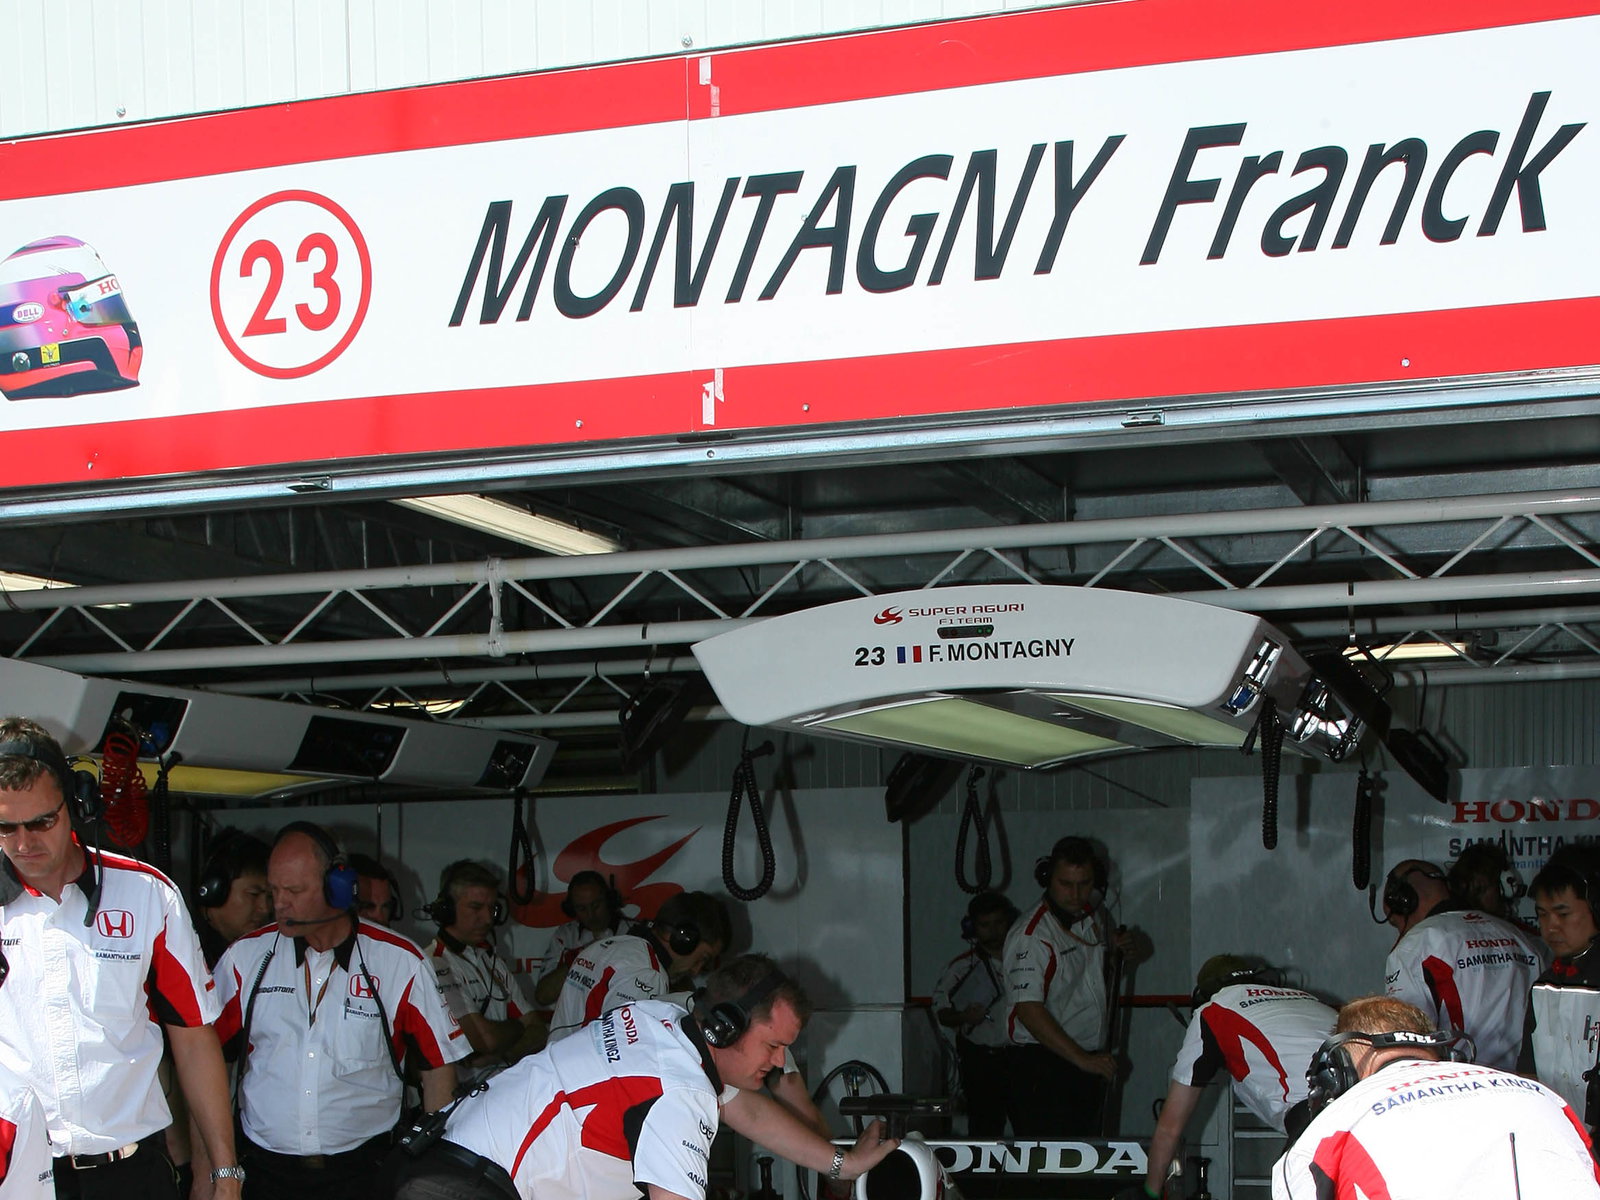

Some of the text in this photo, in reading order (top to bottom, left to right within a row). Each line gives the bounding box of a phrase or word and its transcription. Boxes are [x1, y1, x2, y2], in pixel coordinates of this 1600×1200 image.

[449, 90, 1588, 328] MONTAGNY Franck
[239, 231, 342, 338] 23
[908, 603, 1025, 617] SUPER AGURI
[957, 616, 993, 624] TEAM
[854, 646, 886, 666] 23
[1451, 799, 1600, 823] HOND
[1466, 938, 1520, 949] HONDA
[1457, 952, 1513, 969] SAMANTHA
[620, 1006, 640, 1046] ONDA
[1394, 1032, 1436, 1044] KTEL
[1371, 1080, 1485, 1116] SAMANTHA
[932, 1141, 1149, 1174] ONDA
